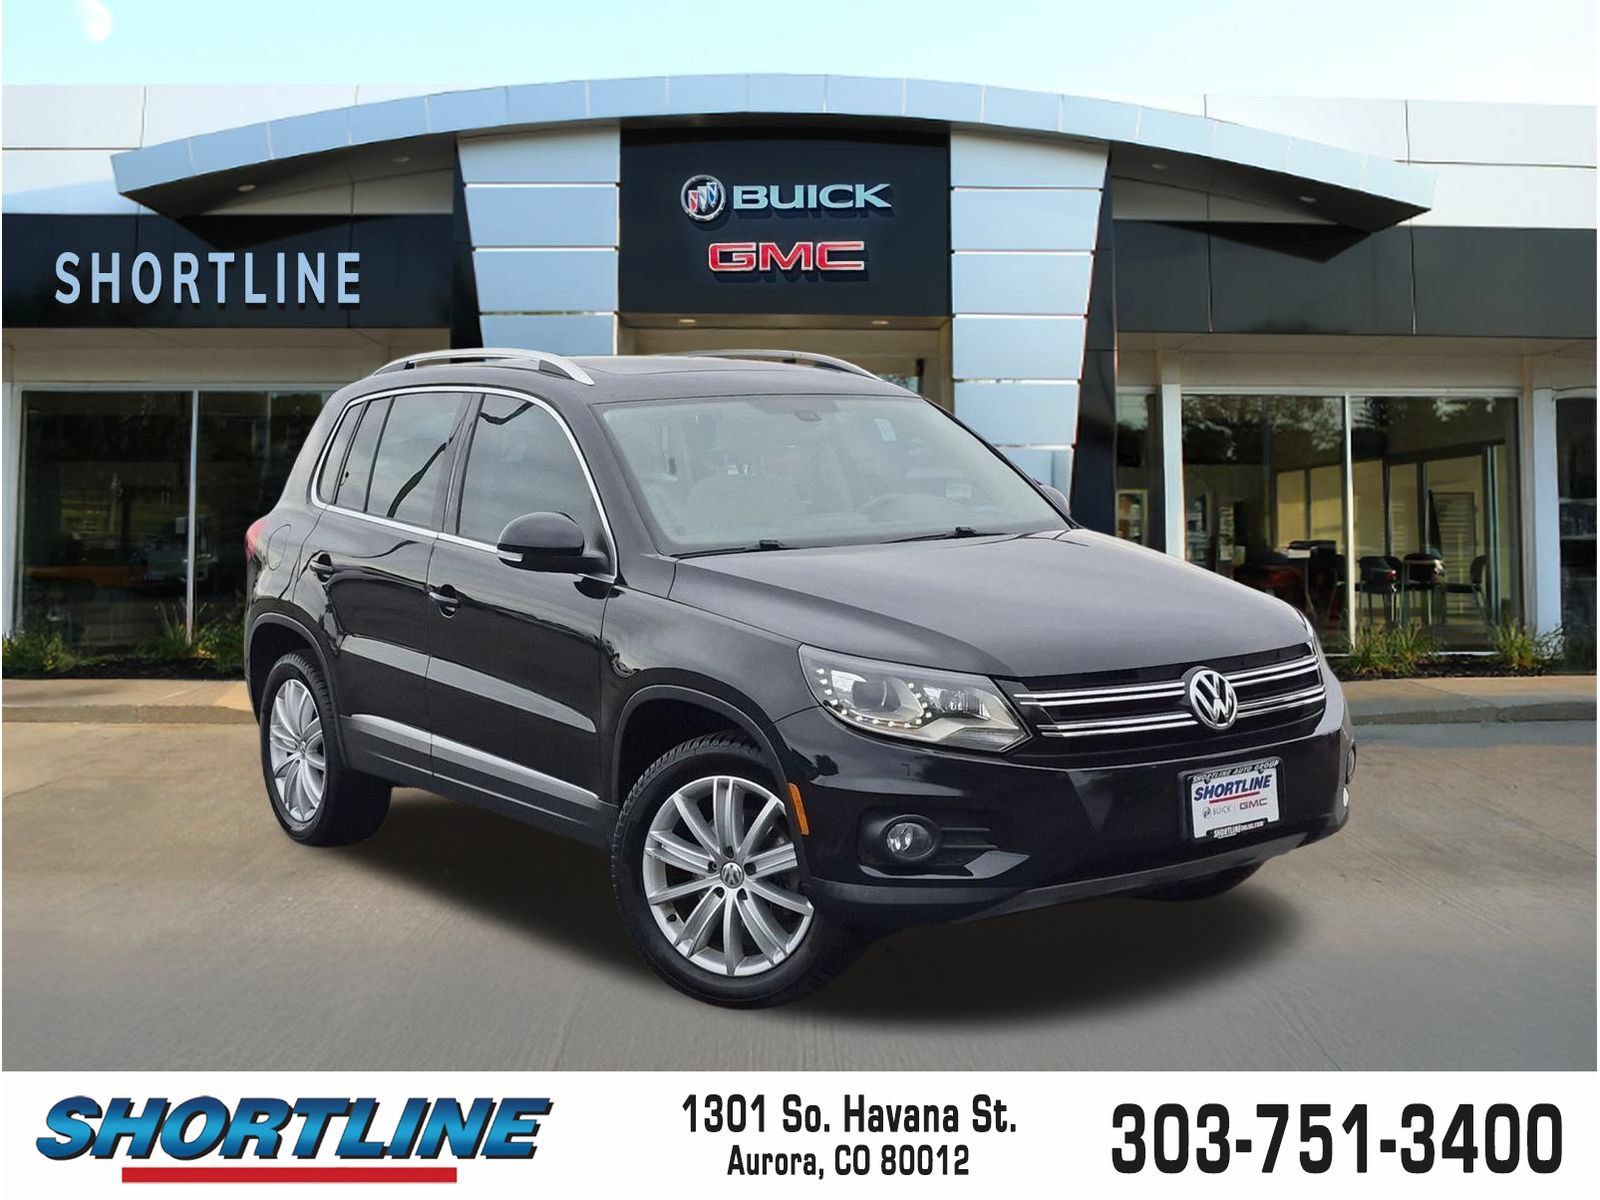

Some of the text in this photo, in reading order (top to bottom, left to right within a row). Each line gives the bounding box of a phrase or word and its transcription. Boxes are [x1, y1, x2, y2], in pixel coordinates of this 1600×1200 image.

[733, 183, 892, 209] BUICK
[708, 241, 865, 271] GMC
[55, 252, 360, 304] SHORTLINE
[1194, 775, 1273, 801] SHORTLINE
[1212, 798, 1268, 816] BUICK GMC
